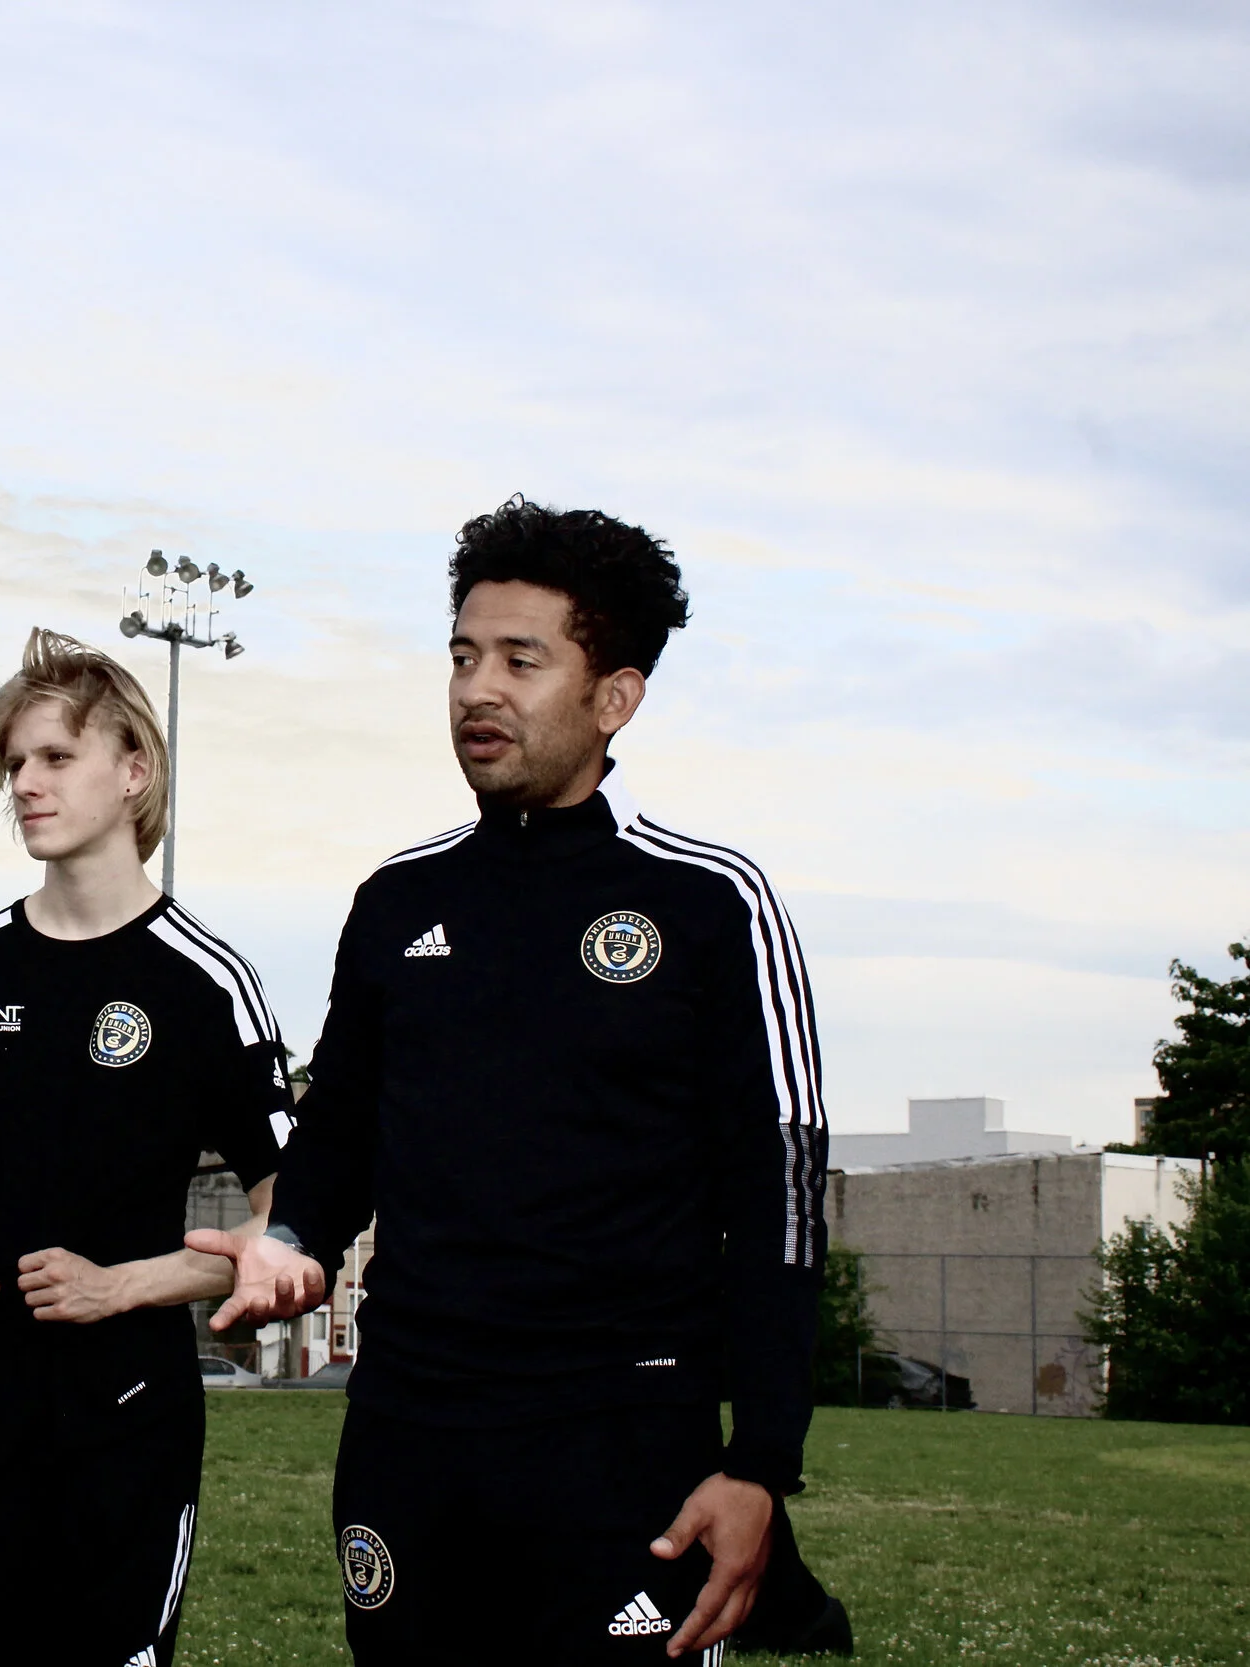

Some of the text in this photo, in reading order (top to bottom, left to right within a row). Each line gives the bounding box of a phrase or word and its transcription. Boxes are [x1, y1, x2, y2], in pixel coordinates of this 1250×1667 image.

[587, 914, 658, 949] PHILADELPHIA
[608, 932, 637, 943] UNION
[404, 944, 452, 957] adidas
[95, 1004, 148, 1042] PHILADELPHIA
[107, 1018, 133, 1034] UNION
[350, 1549, 373, 1565] UNION
[608, 1618, 672, 1636] adidas
